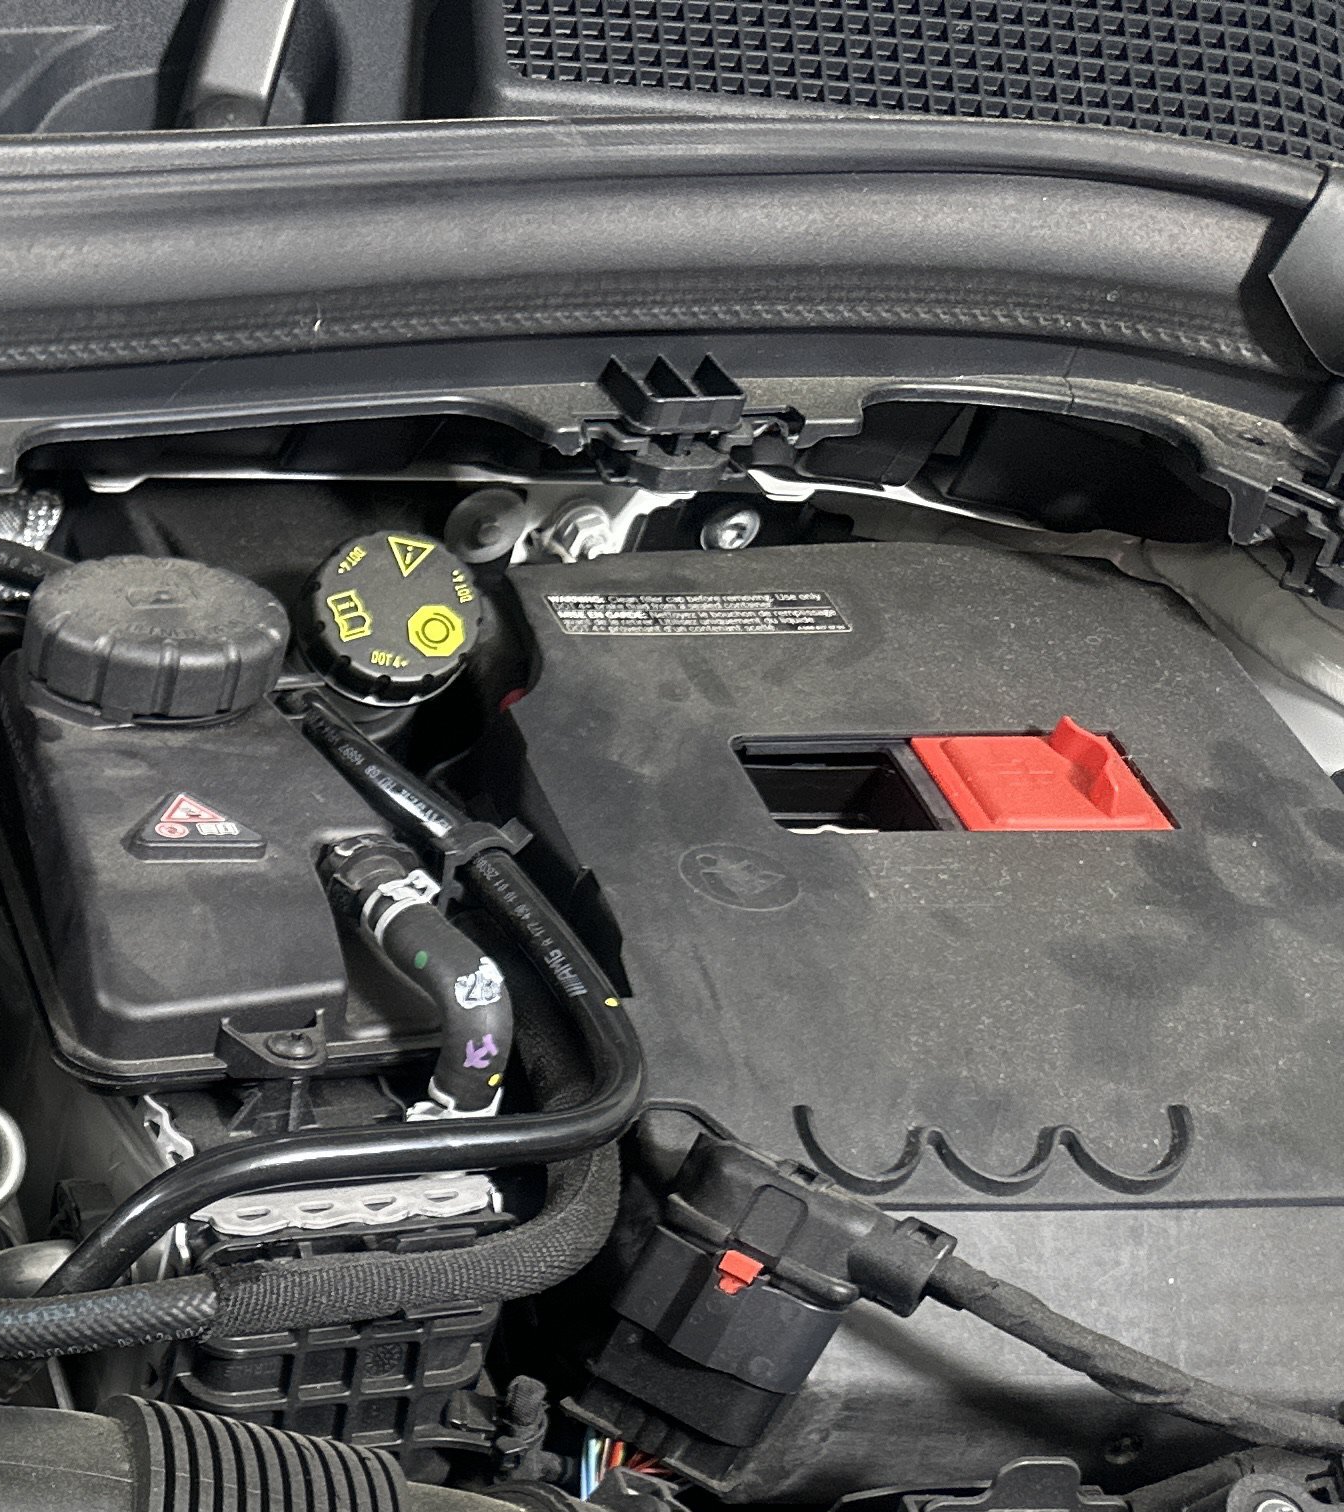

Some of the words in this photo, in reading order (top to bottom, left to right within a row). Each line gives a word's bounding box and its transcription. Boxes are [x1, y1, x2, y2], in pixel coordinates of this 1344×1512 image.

[686, 594, 720, 603] before
[774, 592, 797, 600] Use
[798, 592, 820, 602] only
[371, 650, 392, 667] DOT
